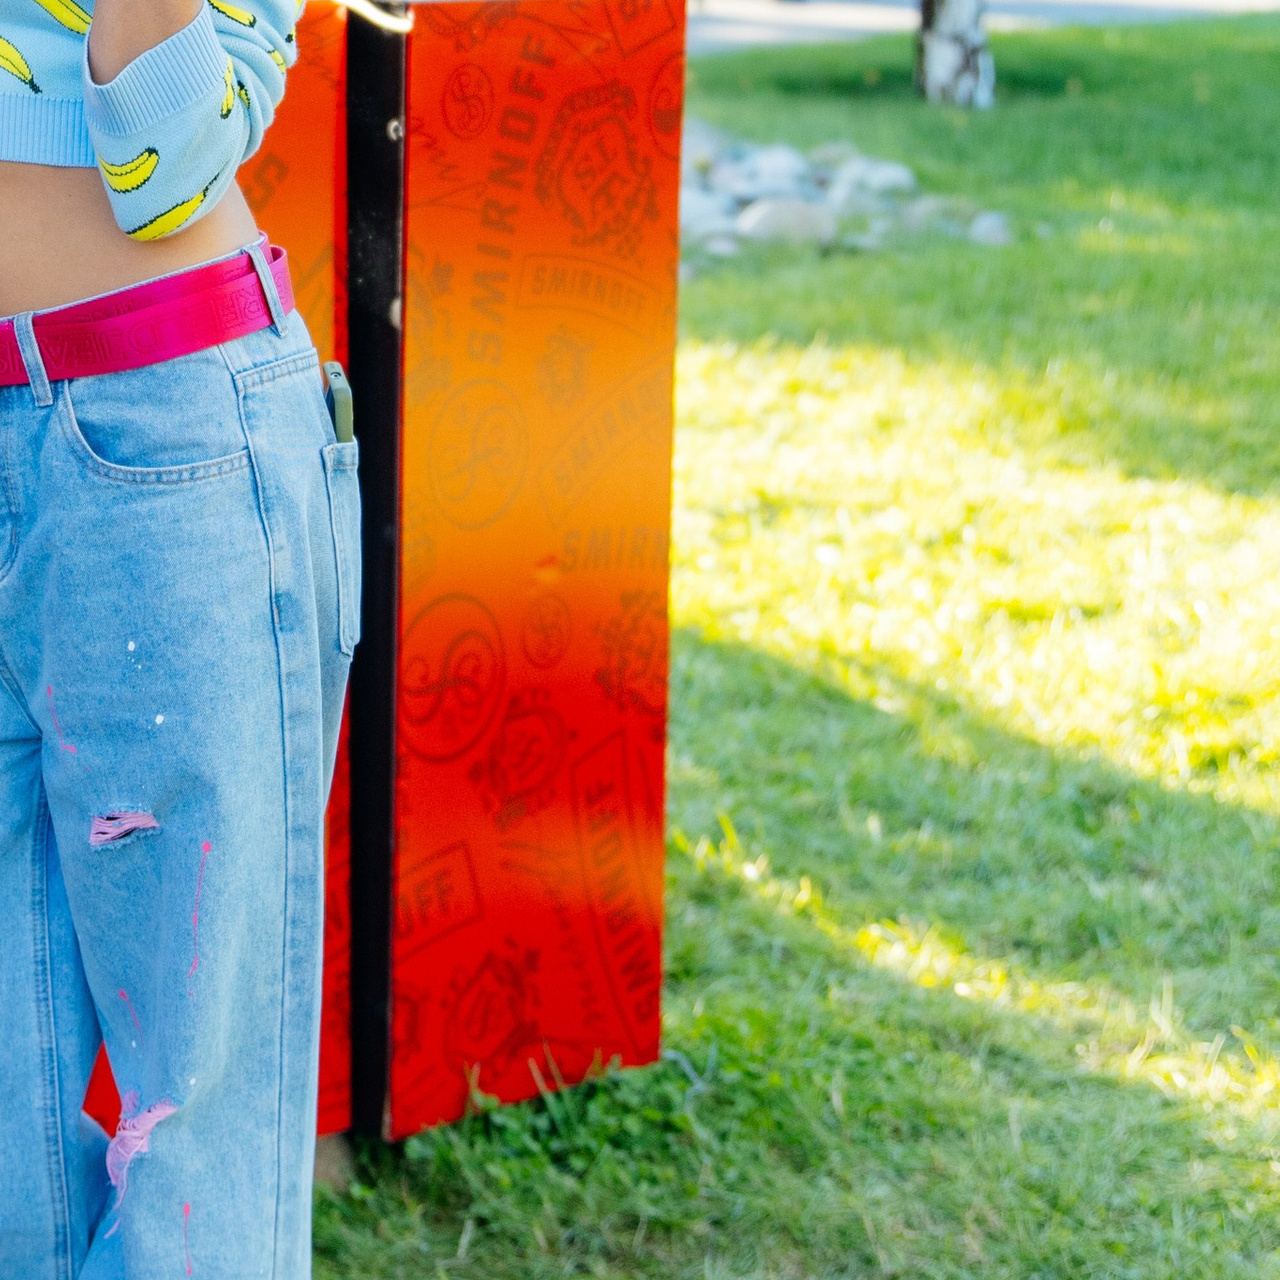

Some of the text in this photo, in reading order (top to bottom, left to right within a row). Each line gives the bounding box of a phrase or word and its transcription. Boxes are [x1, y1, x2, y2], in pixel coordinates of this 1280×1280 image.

[468, 33, 557, 366] SMIRNOFF
[531, 265, 649, 321] SMIRNOFF
[583, 779, 660, 1025] SMIRNOFF
